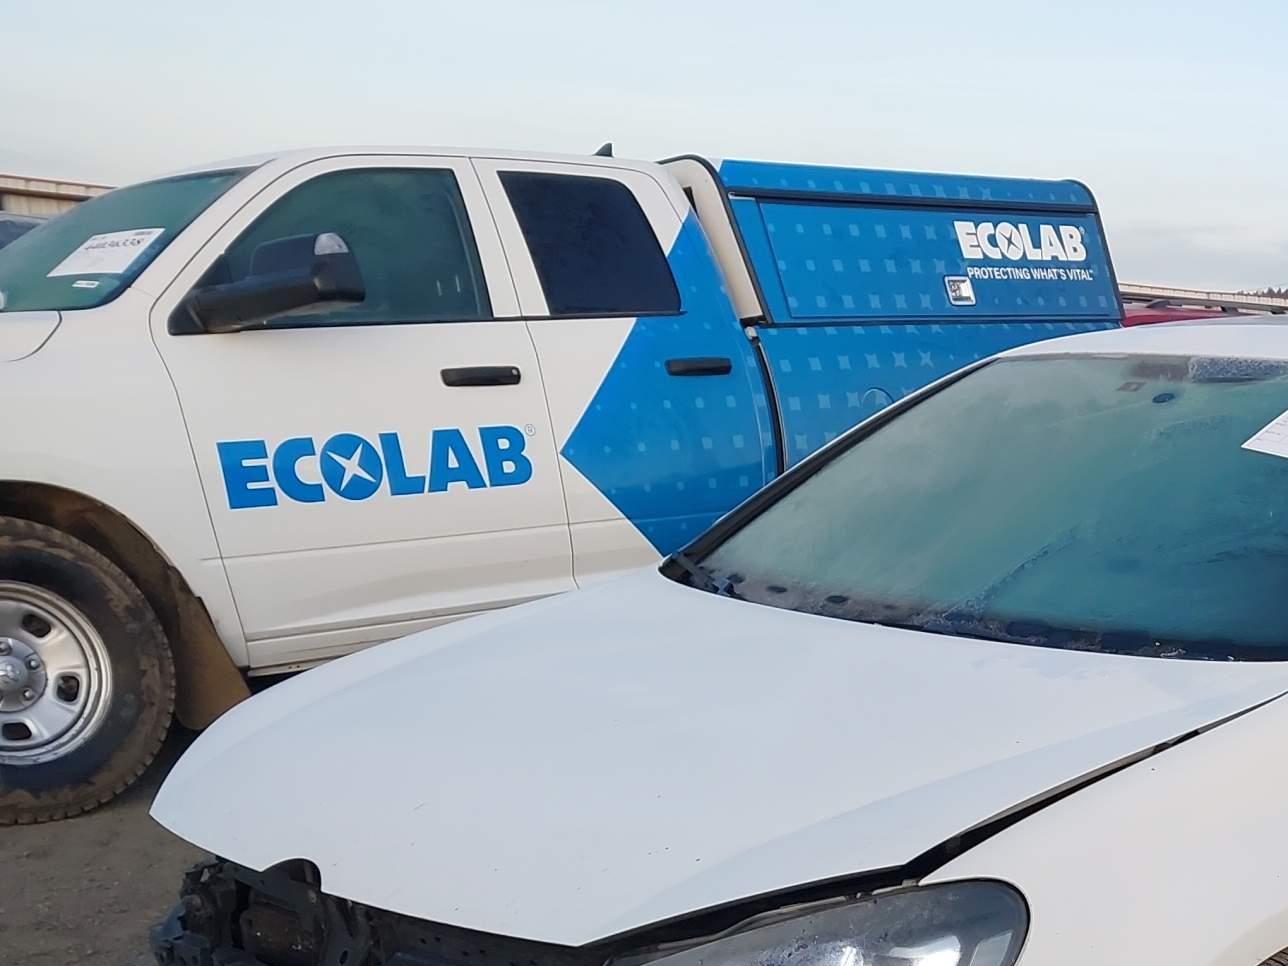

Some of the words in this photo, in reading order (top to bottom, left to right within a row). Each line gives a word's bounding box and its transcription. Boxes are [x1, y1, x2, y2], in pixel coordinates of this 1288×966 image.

[953, 220, 1087, 261] ECOLAB
[966, 266, 1031, 280] PROTECTING
[1029, 267, 1067, 281] WHAT'S
[1066, 268, 1093, 281] VITAL
[216, 425, 533, 510] ECOLAB
